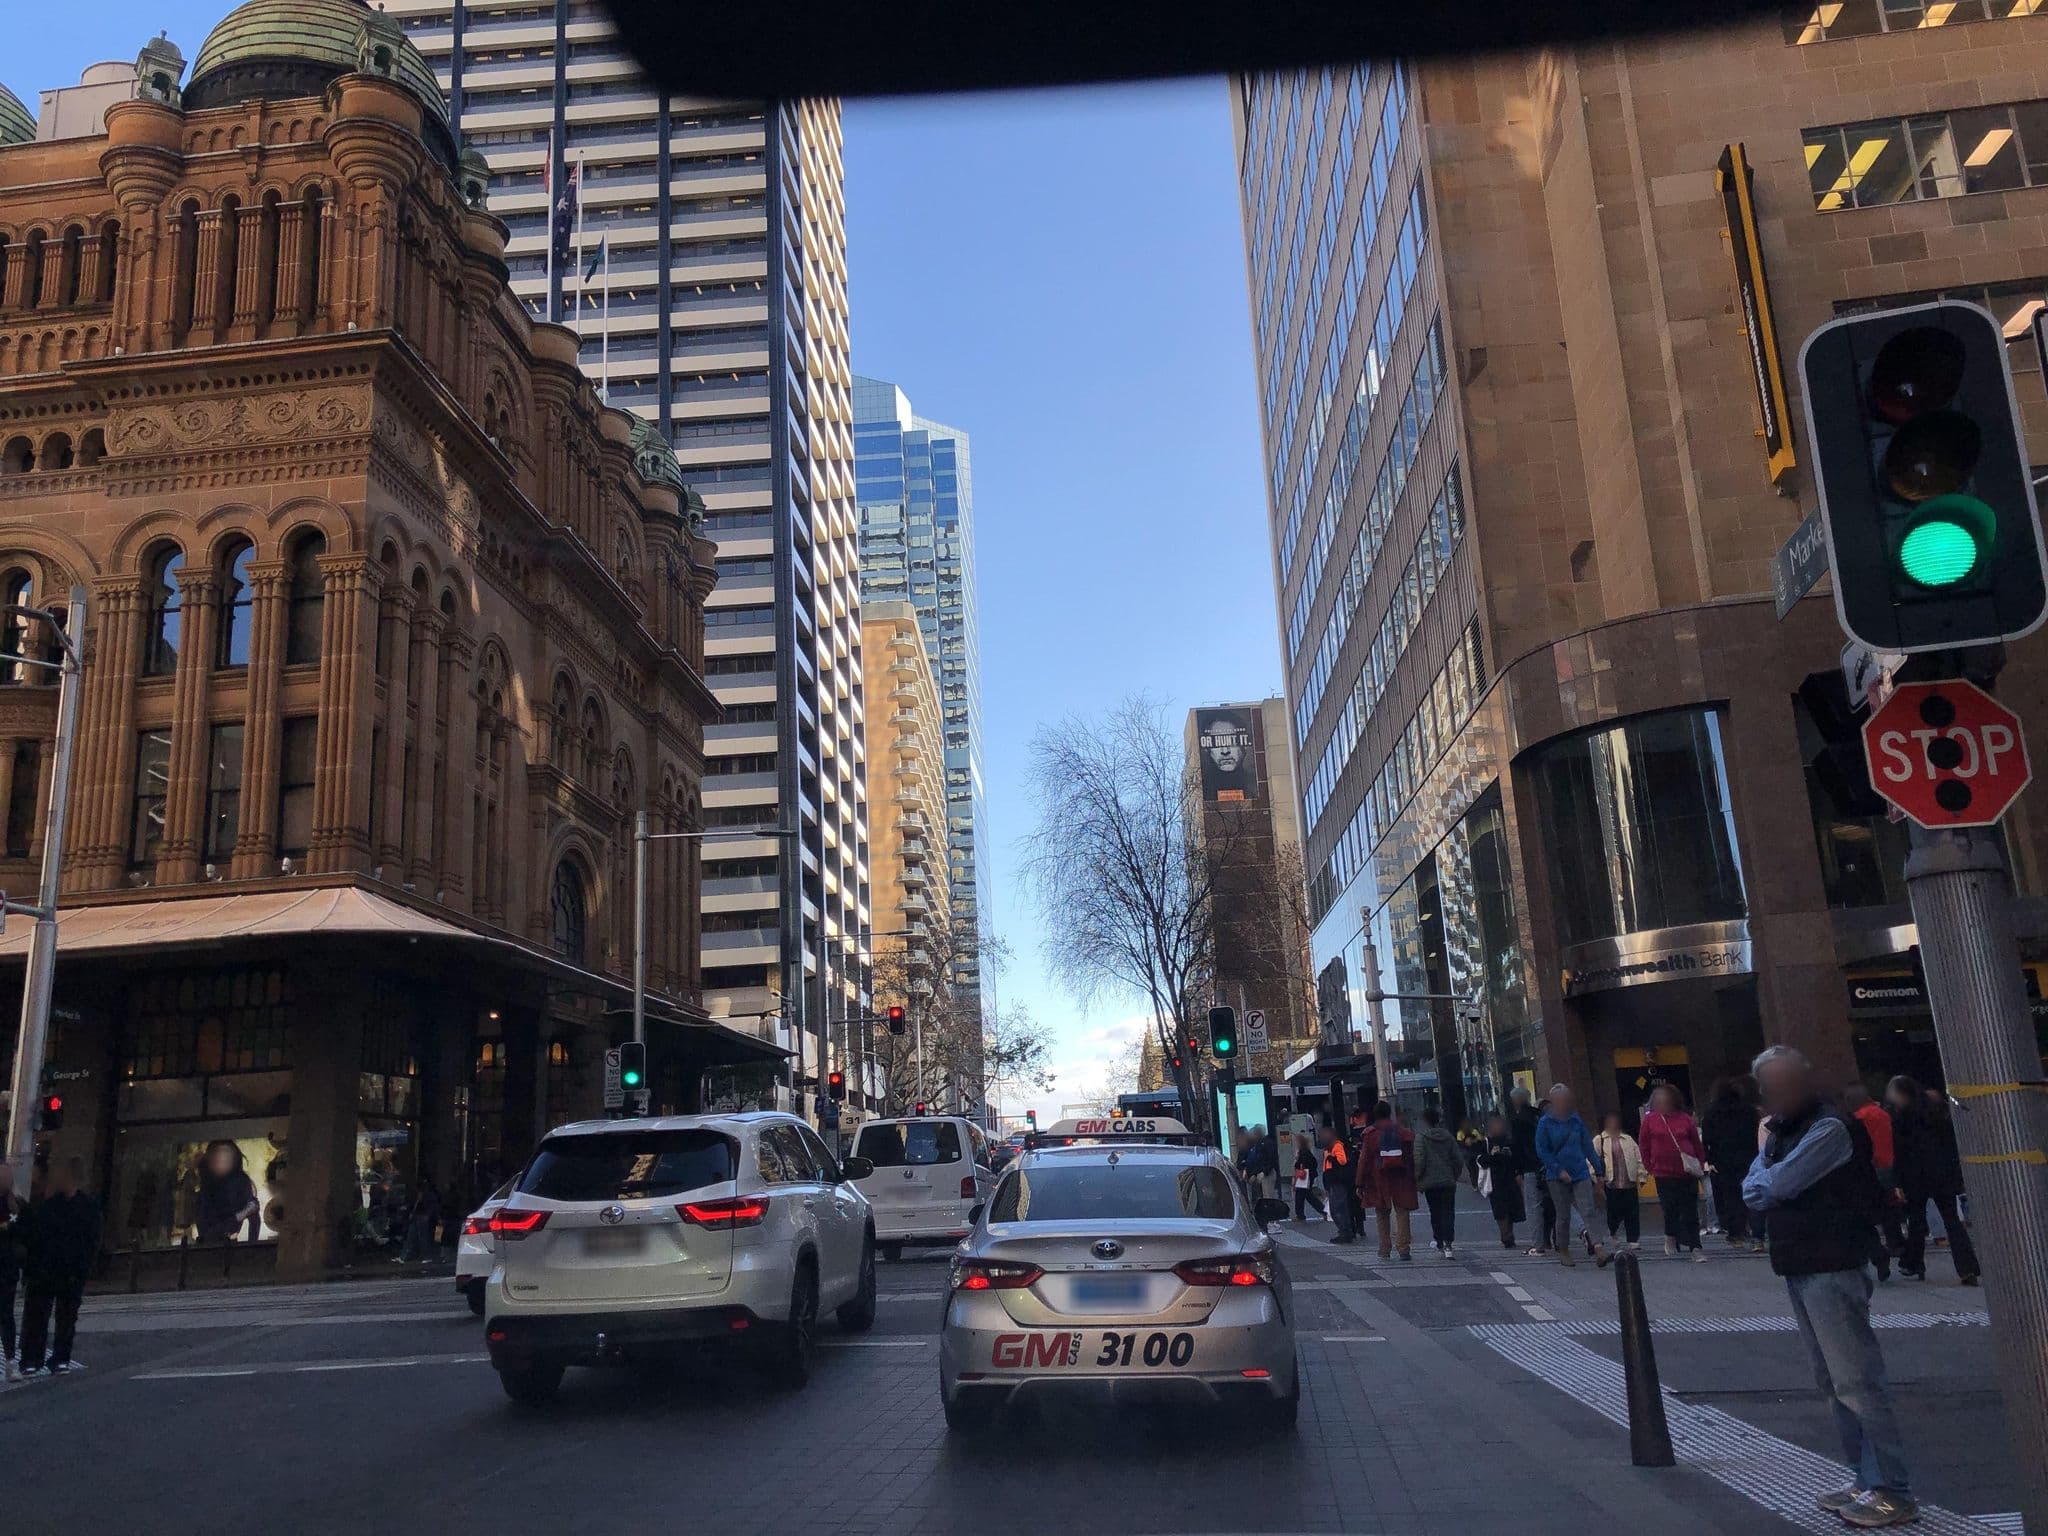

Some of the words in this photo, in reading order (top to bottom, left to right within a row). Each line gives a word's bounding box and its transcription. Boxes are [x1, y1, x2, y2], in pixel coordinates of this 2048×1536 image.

[1789, 521, 1825, 576] Marke
[1200, 736, 1213, 748] OR
[1215, 735, 1238, 747] HUNT
[1880, 724, 2015, 782] STOP
[1700, 950, 1744, 968] Bank
[845, 1116, 861, 1125] 31
[1075, 1120, 1108, 1134] GM
[1112, 1120, 1156, 1133] CABS
[991, 1332, 1072, 1368] GM
[1067, 1332, 1083, 1366] CABS
